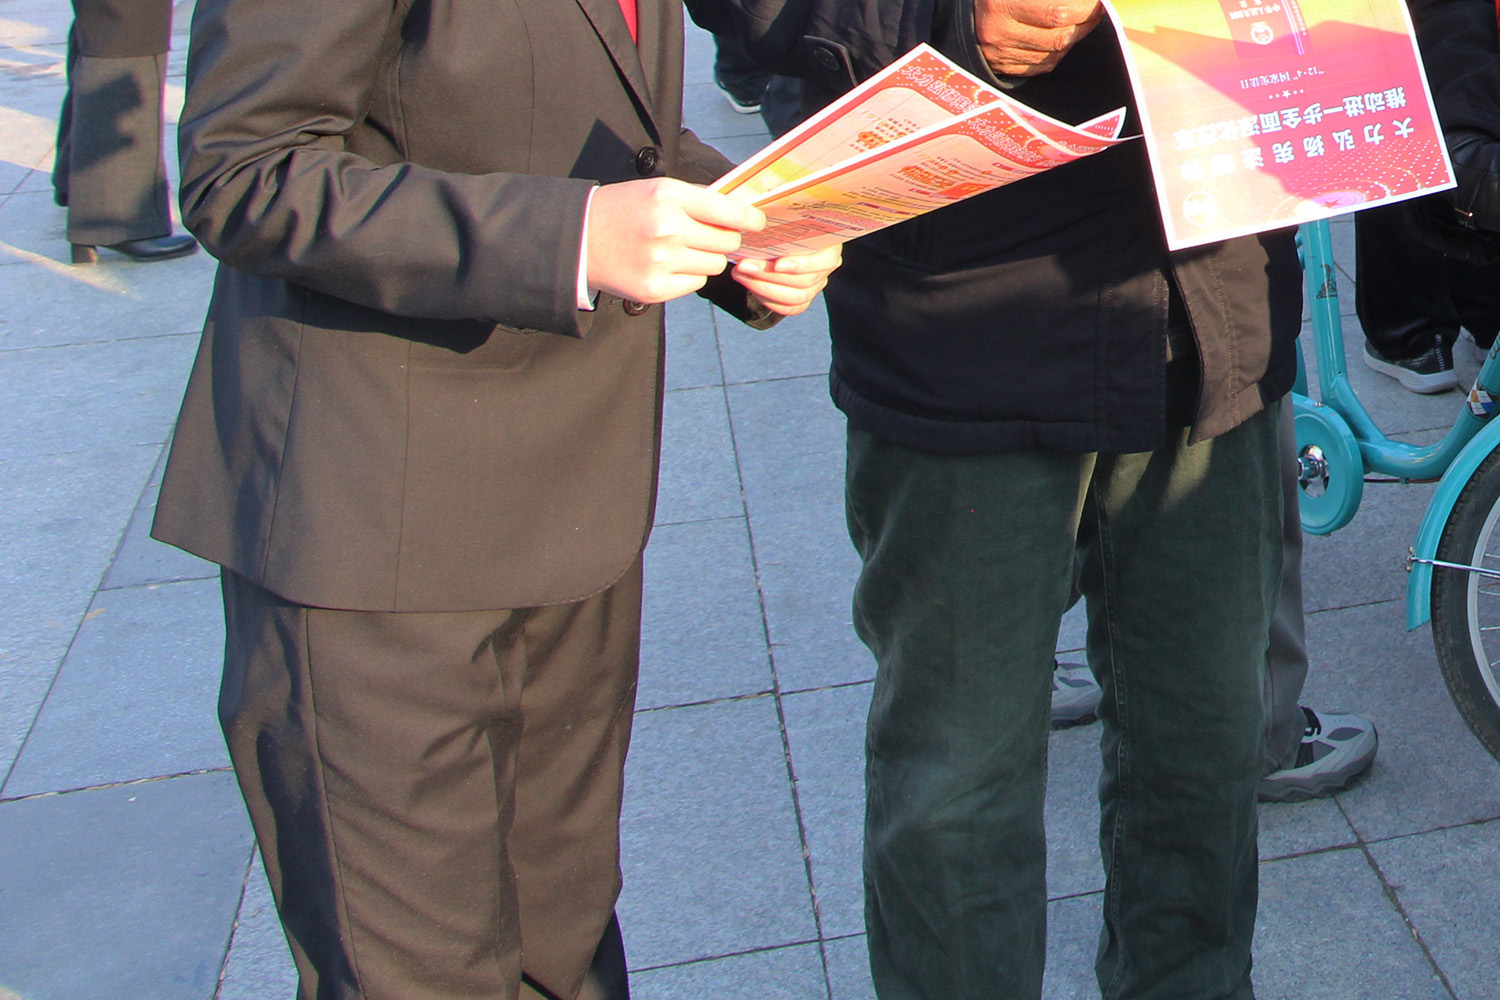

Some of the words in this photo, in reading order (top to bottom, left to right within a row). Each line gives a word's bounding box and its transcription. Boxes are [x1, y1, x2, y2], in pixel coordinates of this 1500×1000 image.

[1180, 116, 1415, 182] 大力弘扬宪法神
